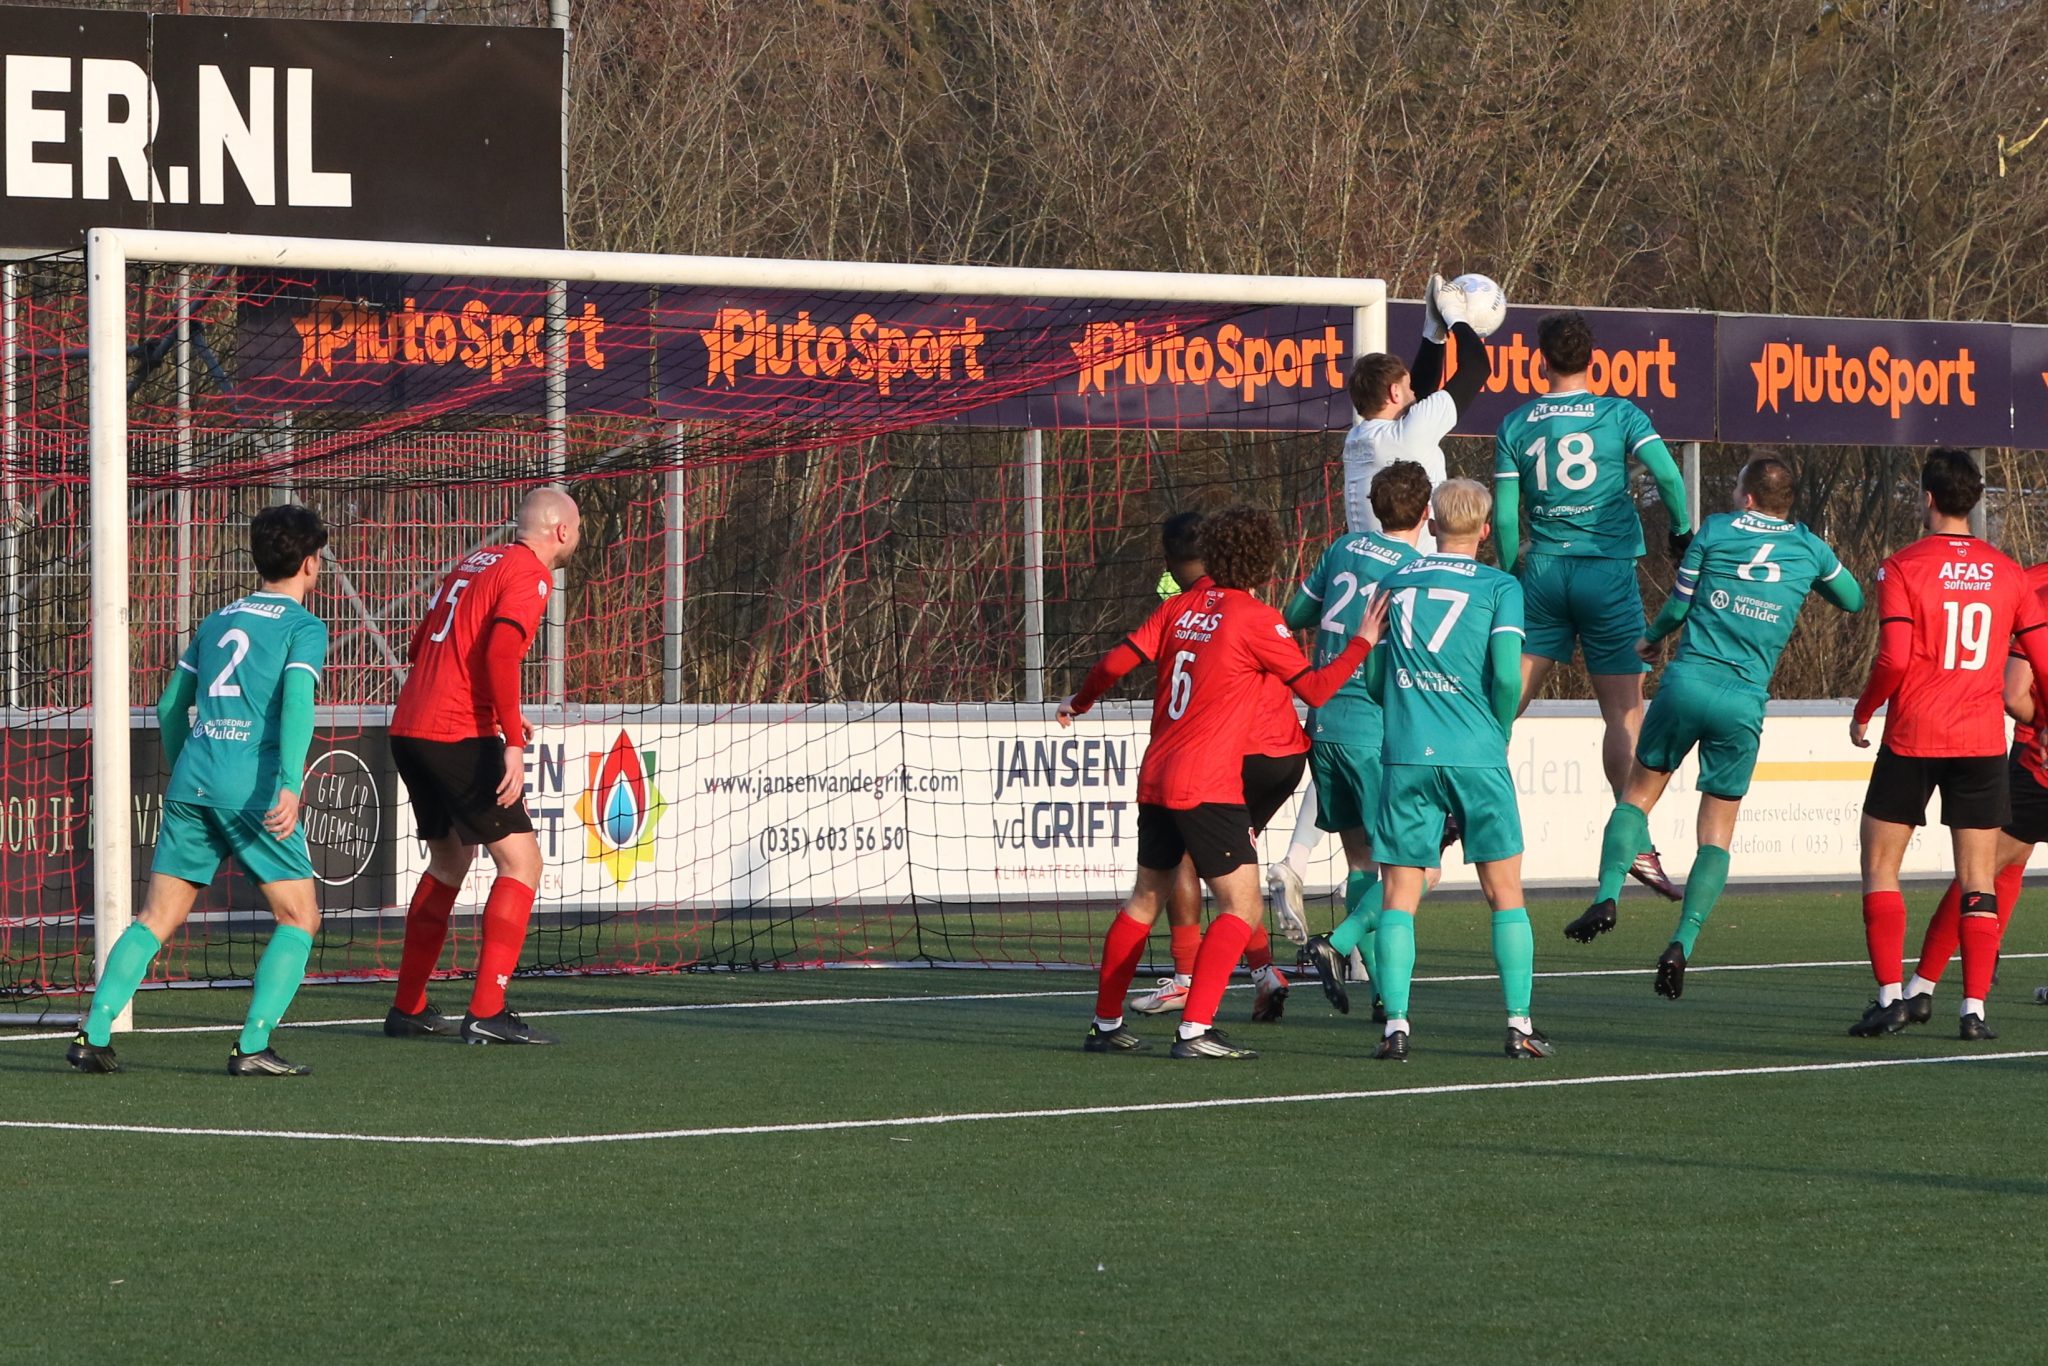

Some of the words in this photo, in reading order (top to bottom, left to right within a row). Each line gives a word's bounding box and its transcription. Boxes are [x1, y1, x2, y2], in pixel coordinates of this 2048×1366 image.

[720, 308, 985, 396] PlutoSport
[1091, 321, 1344, 402] PlutoSport
[1767, 343, 1976, 419] PlutoSport
[1525, 432, 1598, 491] 18
[1736, 543, 1781, 583] 6
[1938, 562, 1994, 580] AFAS
[1944, 579, 1992, 590] software
[1175, 610, 1223, 632] AFAS
[1391, 587, 1470, 654] 17
[1731, 602, 1779, 624] Mulder
[1943, 601, 1992, 671] 19
[208, 628, 250, 698] 2
[1168, 650, 1197, 720] 6
[704, 769, 959, 800] www.jansenvandegrift.com
[994, 740, 1127, 800] JANSEN
[0, 796, 38, 852] OR
[759, 827, 809, 860] (035)
[816, 826, 847, 852] 603
[855, 827, 875, 851] 56
[883, 827, 904, 851] 50
[993, 806, 1025, 849] vd
[1031, 801, 1127, 849] GRIFT
[1732, 834, 1782, 854] elefoon
[994, 864, 1125, 880] KLIMAATTECHNIEK
